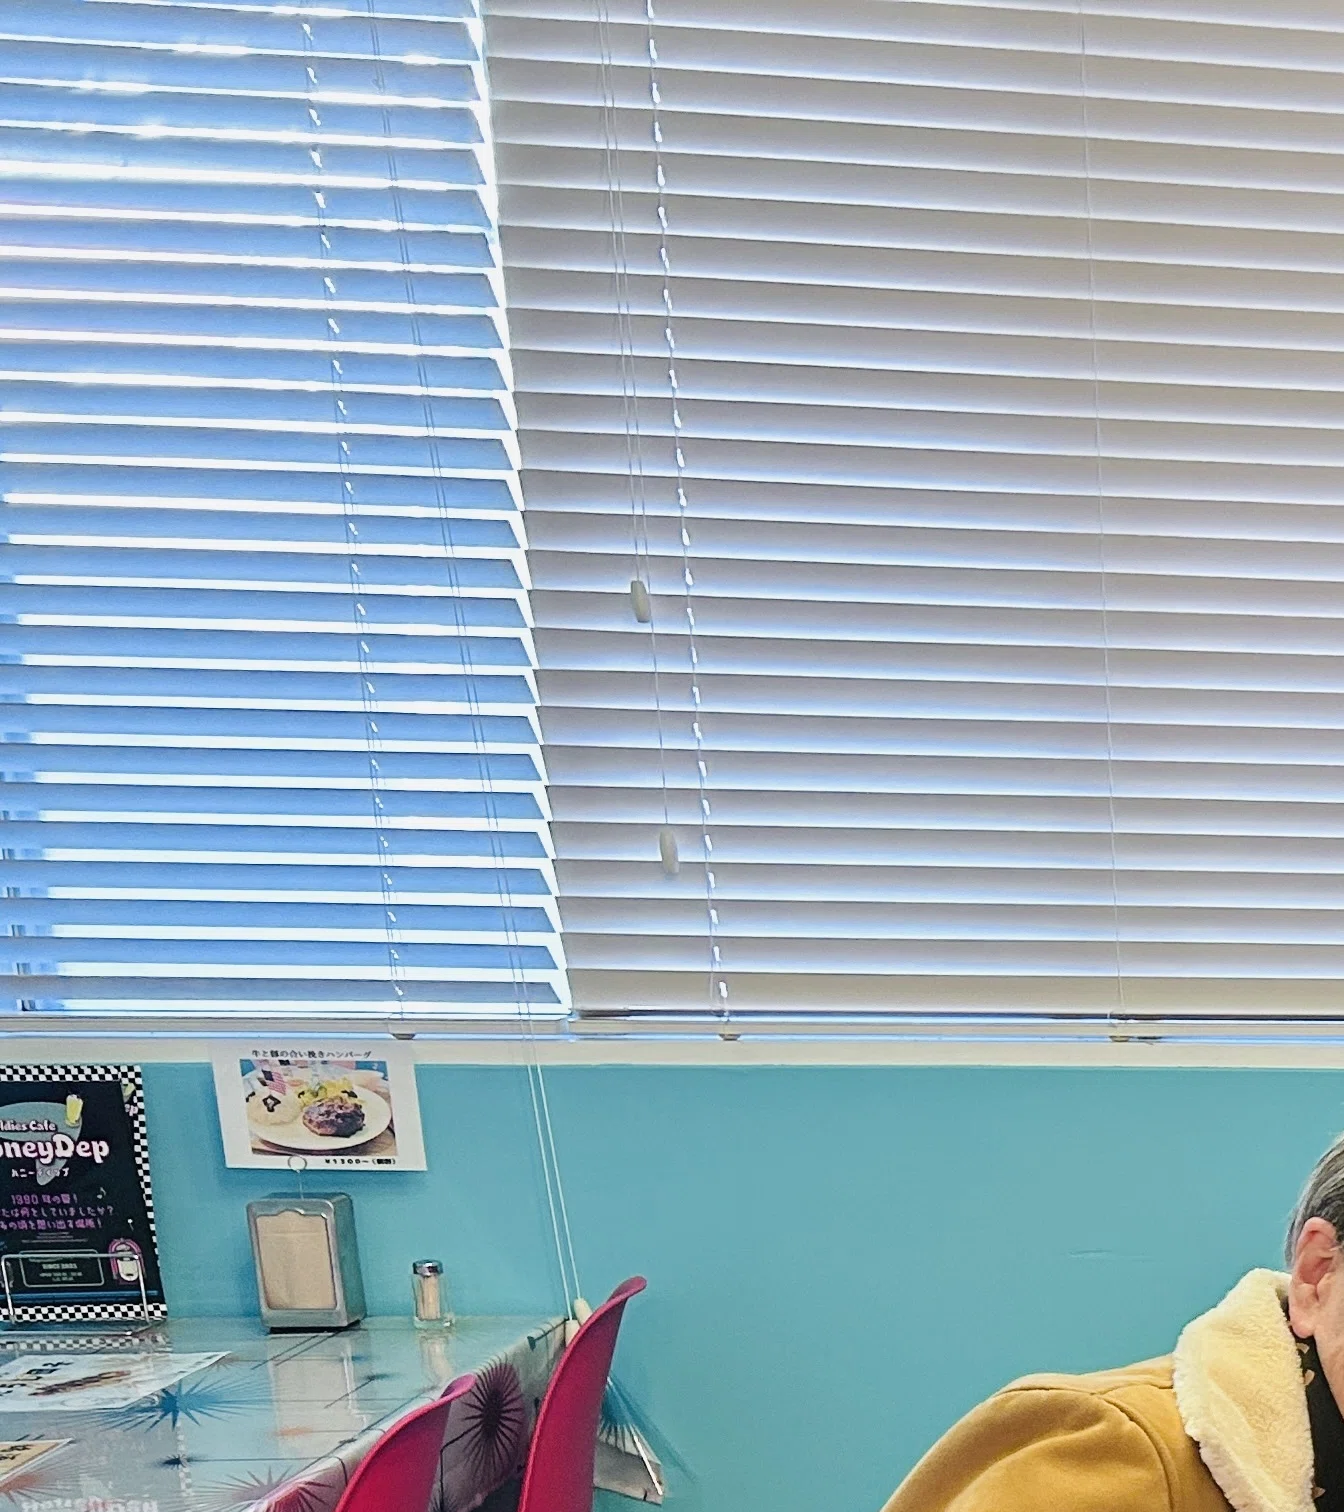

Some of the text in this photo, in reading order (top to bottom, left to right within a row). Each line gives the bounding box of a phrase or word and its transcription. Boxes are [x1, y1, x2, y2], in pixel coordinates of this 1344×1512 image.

[0, 1120, 57, 1132] ldies Cafe
[0, 1133, 110, 1164] neyDep
